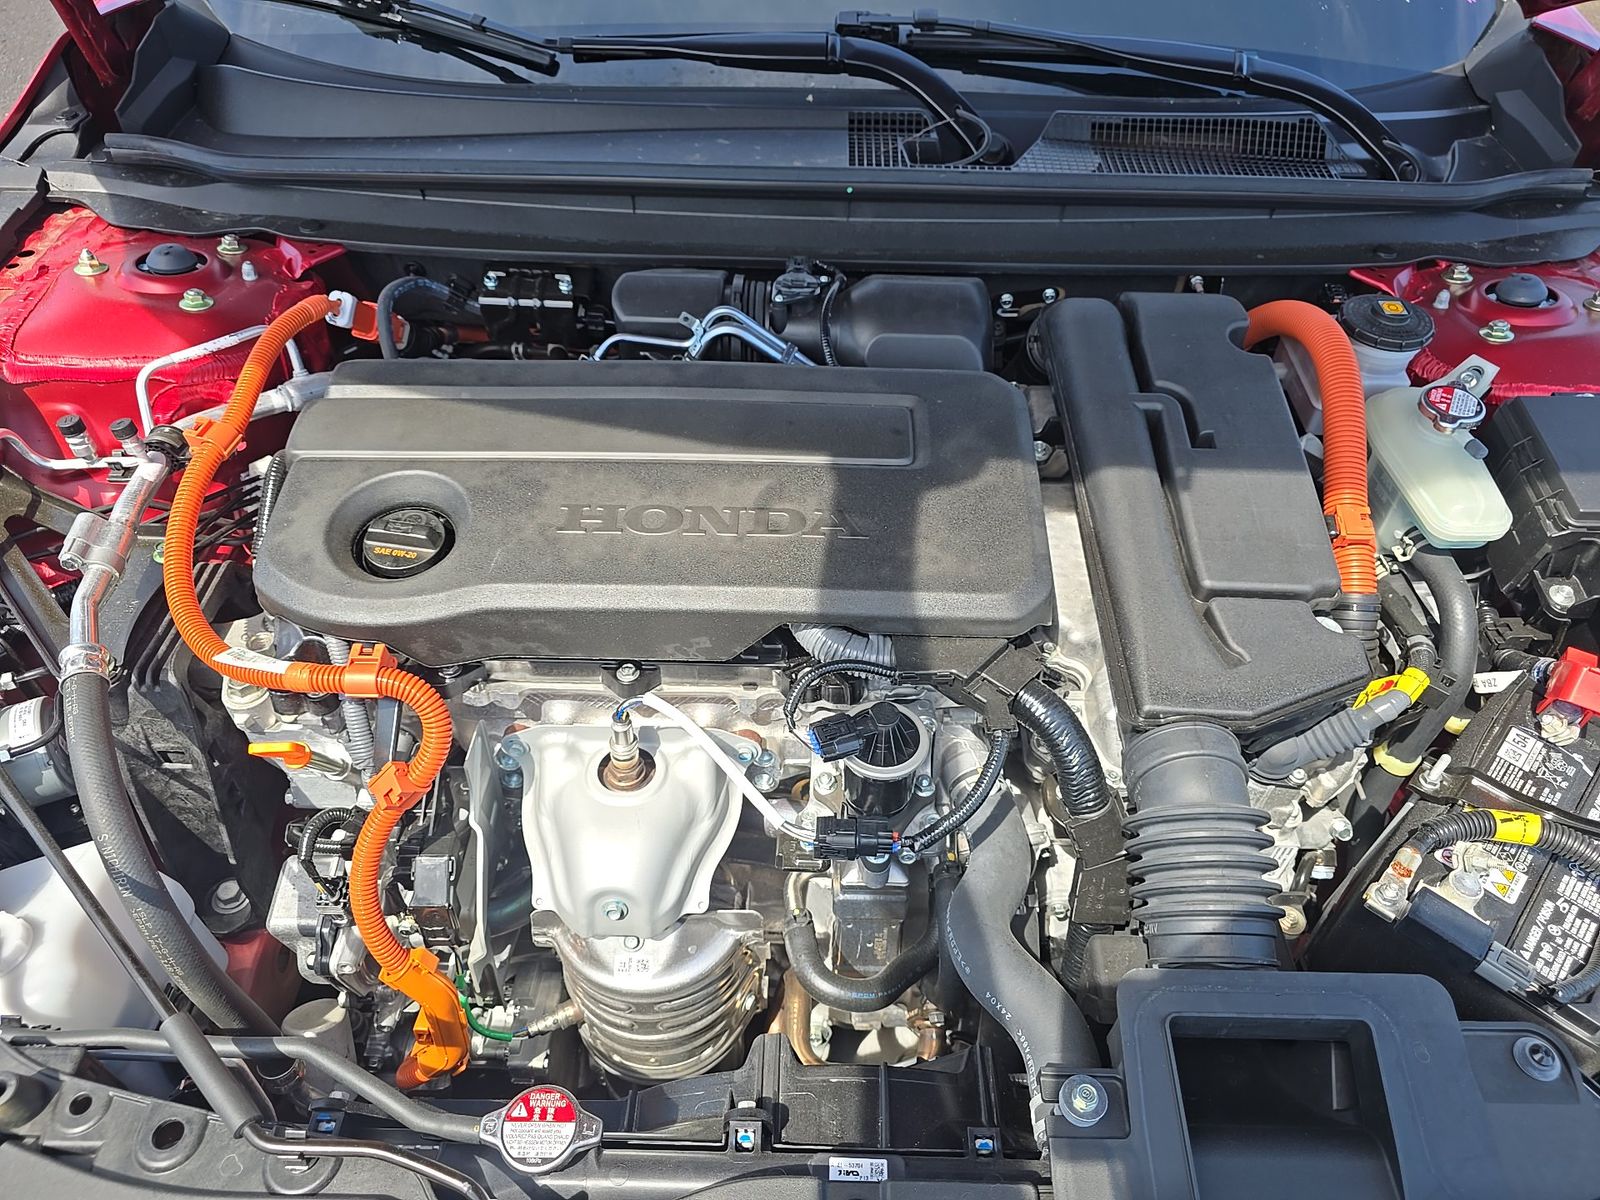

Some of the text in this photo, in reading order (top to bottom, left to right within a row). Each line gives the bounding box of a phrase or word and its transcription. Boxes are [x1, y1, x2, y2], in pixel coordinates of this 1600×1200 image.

[556, 503, 870, 539] HONDA
[373, 546, 418, 560] SAE 0W-20
[985, 991, 1013, 1021] 24X04
[529, 1092, 561, 1100] DANGER
[529, 1099, 566, 1108] WARNUNG
